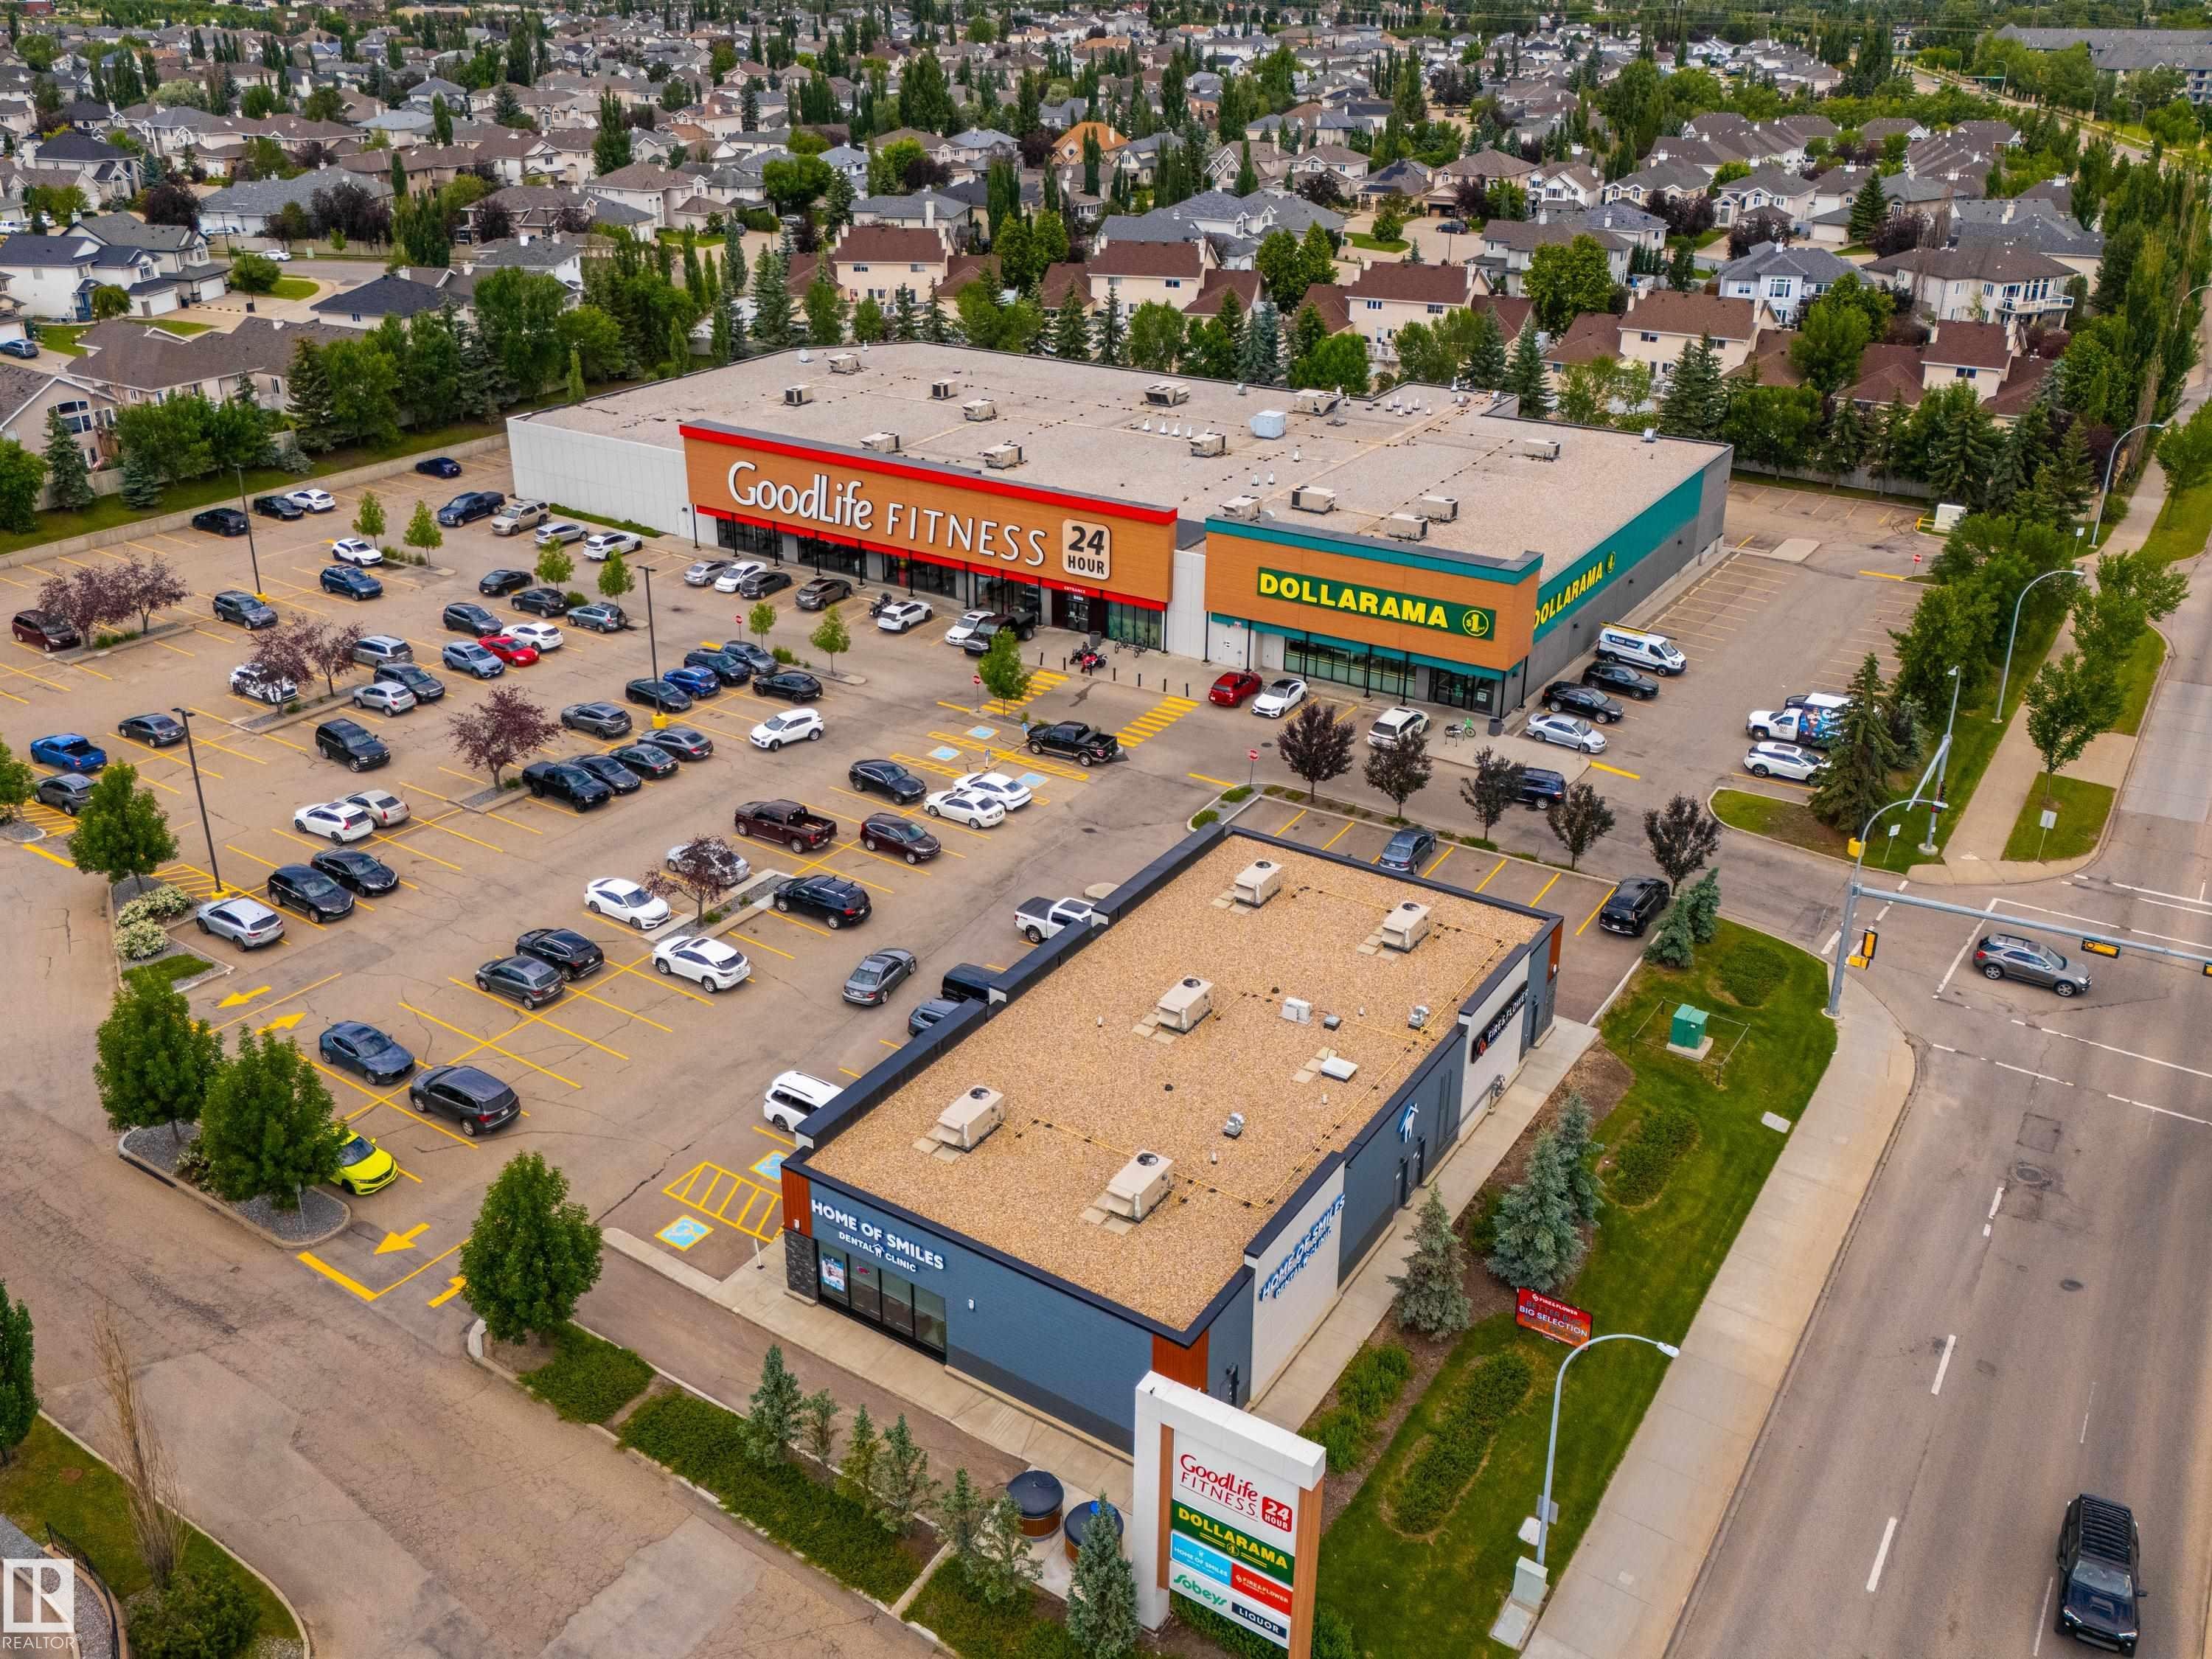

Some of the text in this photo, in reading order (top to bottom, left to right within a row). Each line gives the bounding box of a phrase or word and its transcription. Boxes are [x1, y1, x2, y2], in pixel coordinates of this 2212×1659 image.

[728, 461, 1047, 566] GoodLife FITNESS
[1068, 525, 1105, 556] 24
[1068, 554, 1105, 575] HOUR
[1259, 572, 1449, 628] DOLLARAMA
[811, 1199, 945, 1270] HOME OF SMILES
[838, 1231, 874, 1254] DENTAL
[885, 1252, 917, 1273] CLINIC
[1260, 1251, 1295, 1301] HOME
[1310, 1193, 1346, 1242] SMILES
[1519, 1305, 1535, 1316] BIG
[1537, 1312, 1587, 1338] SELECTION
[1180, 1454, 1258, 1502] GoodLife
[1181, 1472, 1256, 1516] FITNESS
[1265, 1500, 1290, 1521] 24
[1265, 1514, 1288, 1530] HOUR
[1178, 1507, 1288, 1570] DOLLARAMA
[1174, 1546, 1194, 1560] HOME
[1205, 1562, 1228, 1577] SMILES
[1239, 1607, 1280, 1634] LIQUOR
